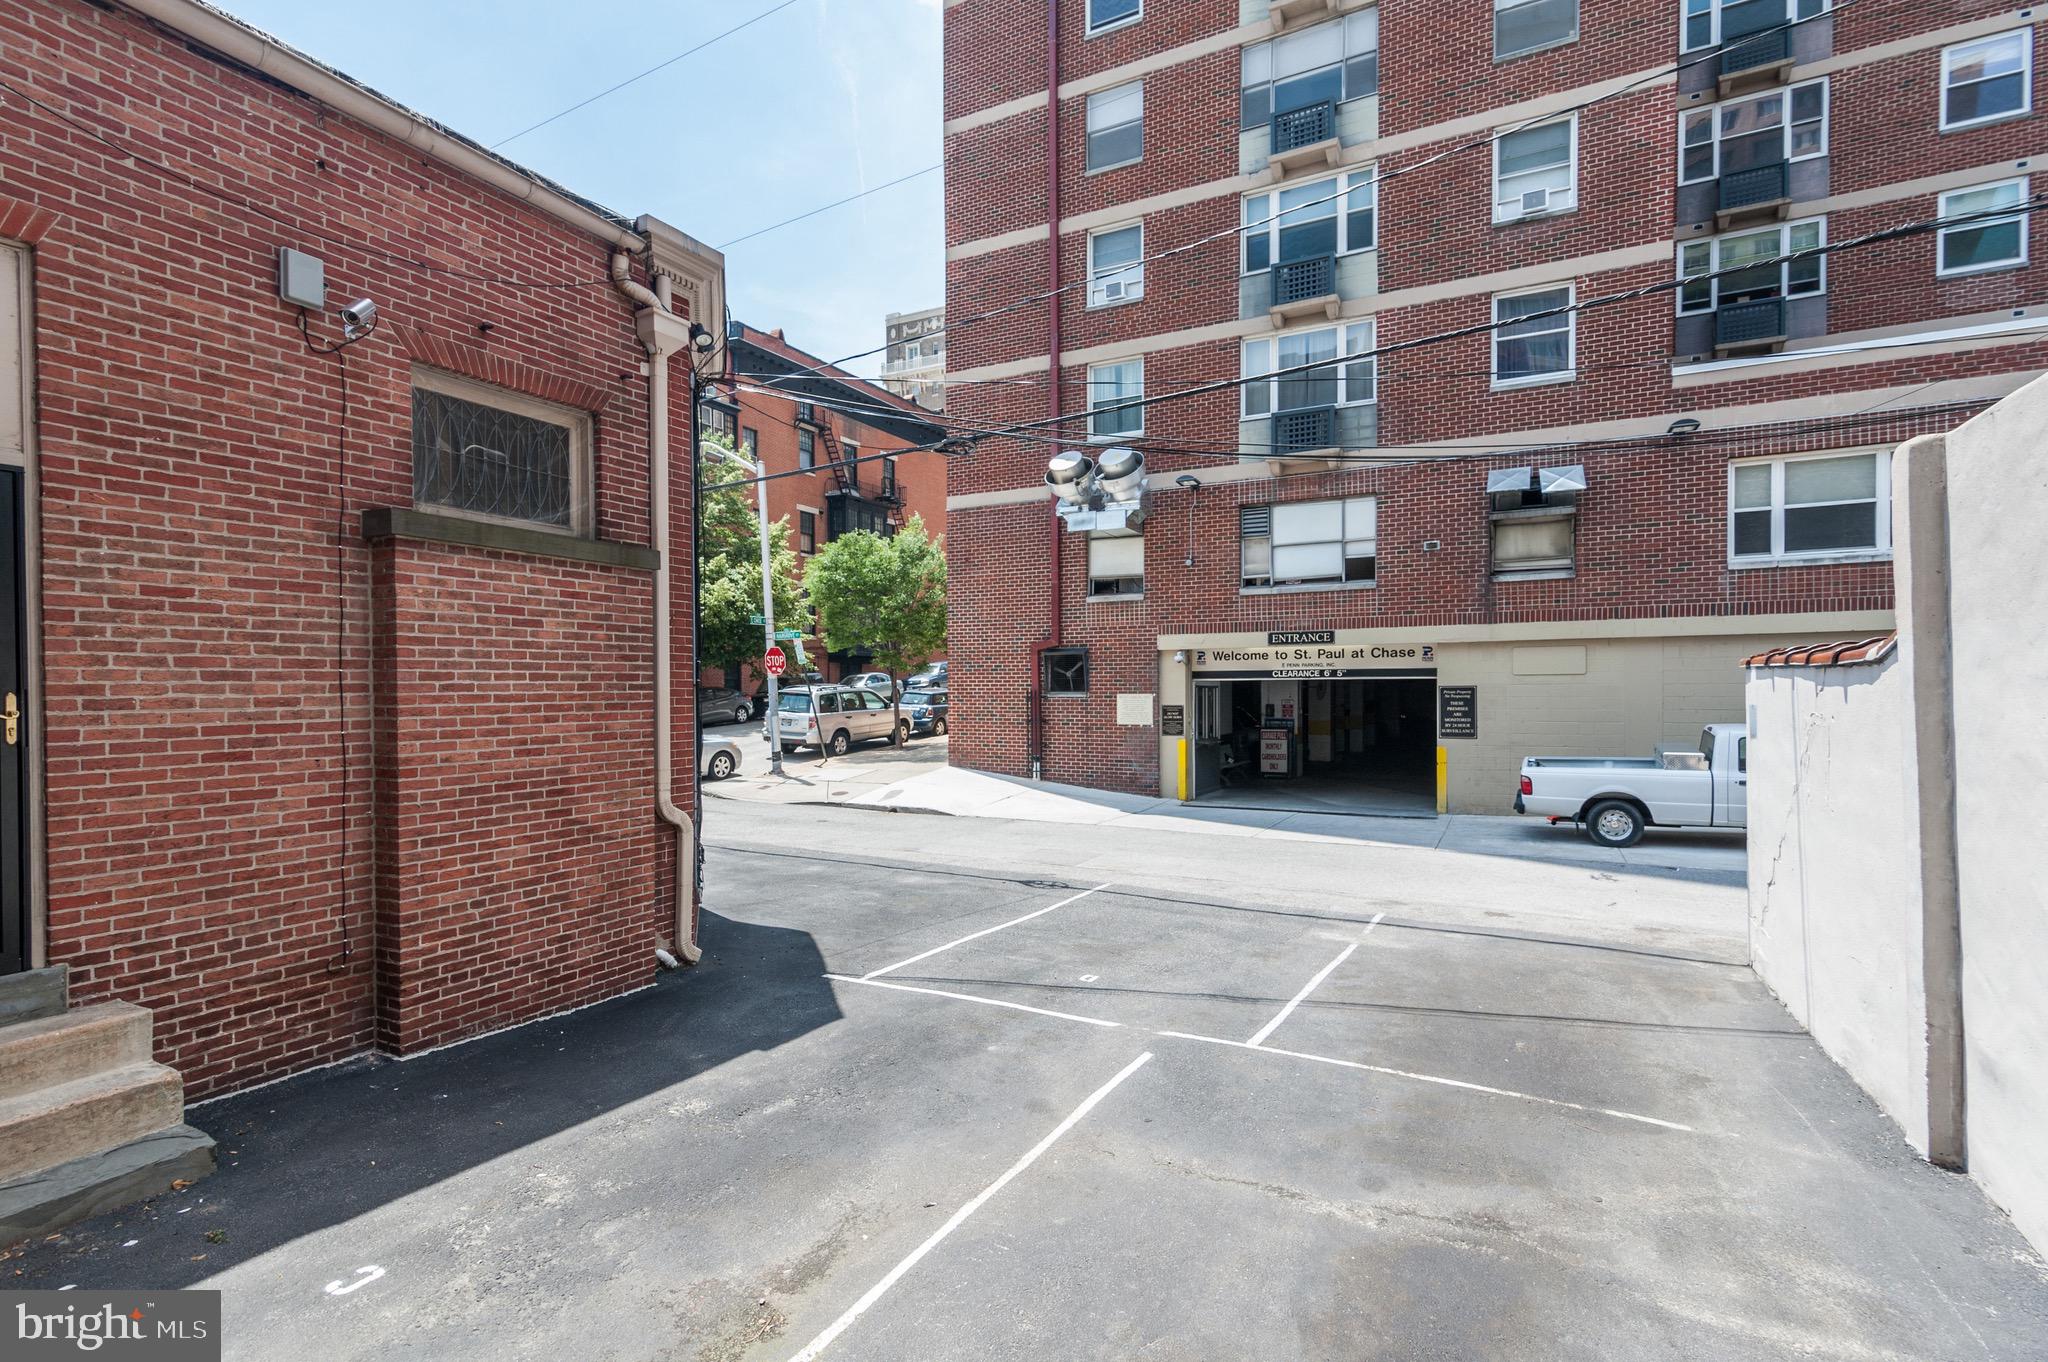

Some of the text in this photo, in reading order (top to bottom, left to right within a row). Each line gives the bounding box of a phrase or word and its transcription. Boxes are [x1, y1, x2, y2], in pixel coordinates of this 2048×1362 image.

[1272, 632, 1331, 643] ENTRANCE
[1212, 647, 1416, 661] Welcome to St. Paul at Chase
[766, 655, 784, 667] STOP
[1272, 670, 1320, 678] CLEARANCE
